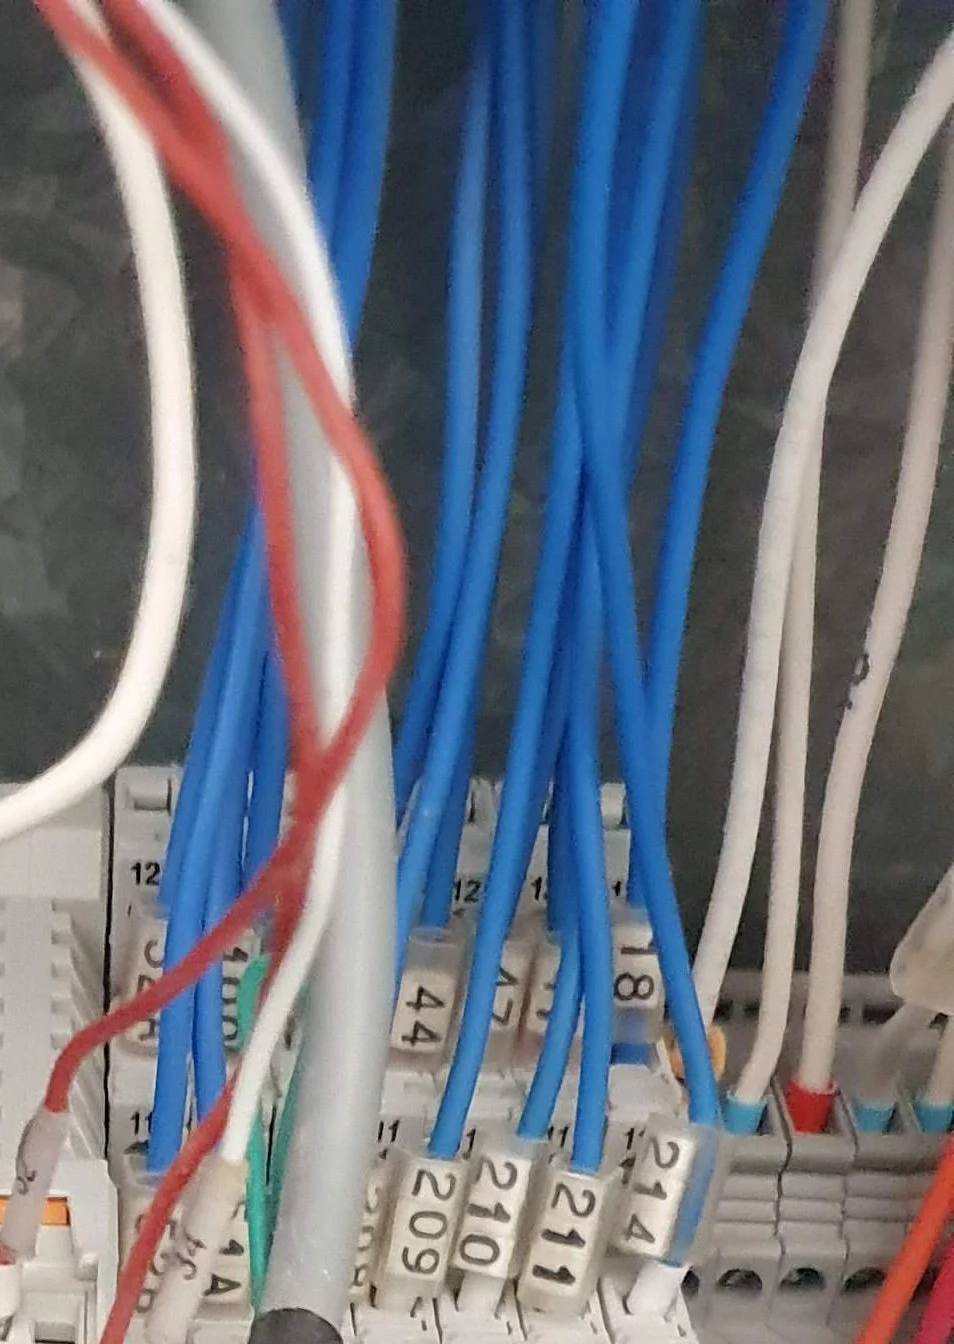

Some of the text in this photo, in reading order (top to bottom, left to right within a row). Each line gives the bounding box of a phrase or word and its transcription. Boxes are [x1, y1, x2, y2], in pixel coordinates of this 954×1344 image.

[130, 862, 160, 885] 12
[453, 879, 482, 903] 12
[401, 985, 444, 1046] 44
[401, 1169, 456, 1274] 209
[458, 1158, 518, 1266] 210
[532, 1183, 596, 1286] 211
[624, 1134, 680, 1245] 214
